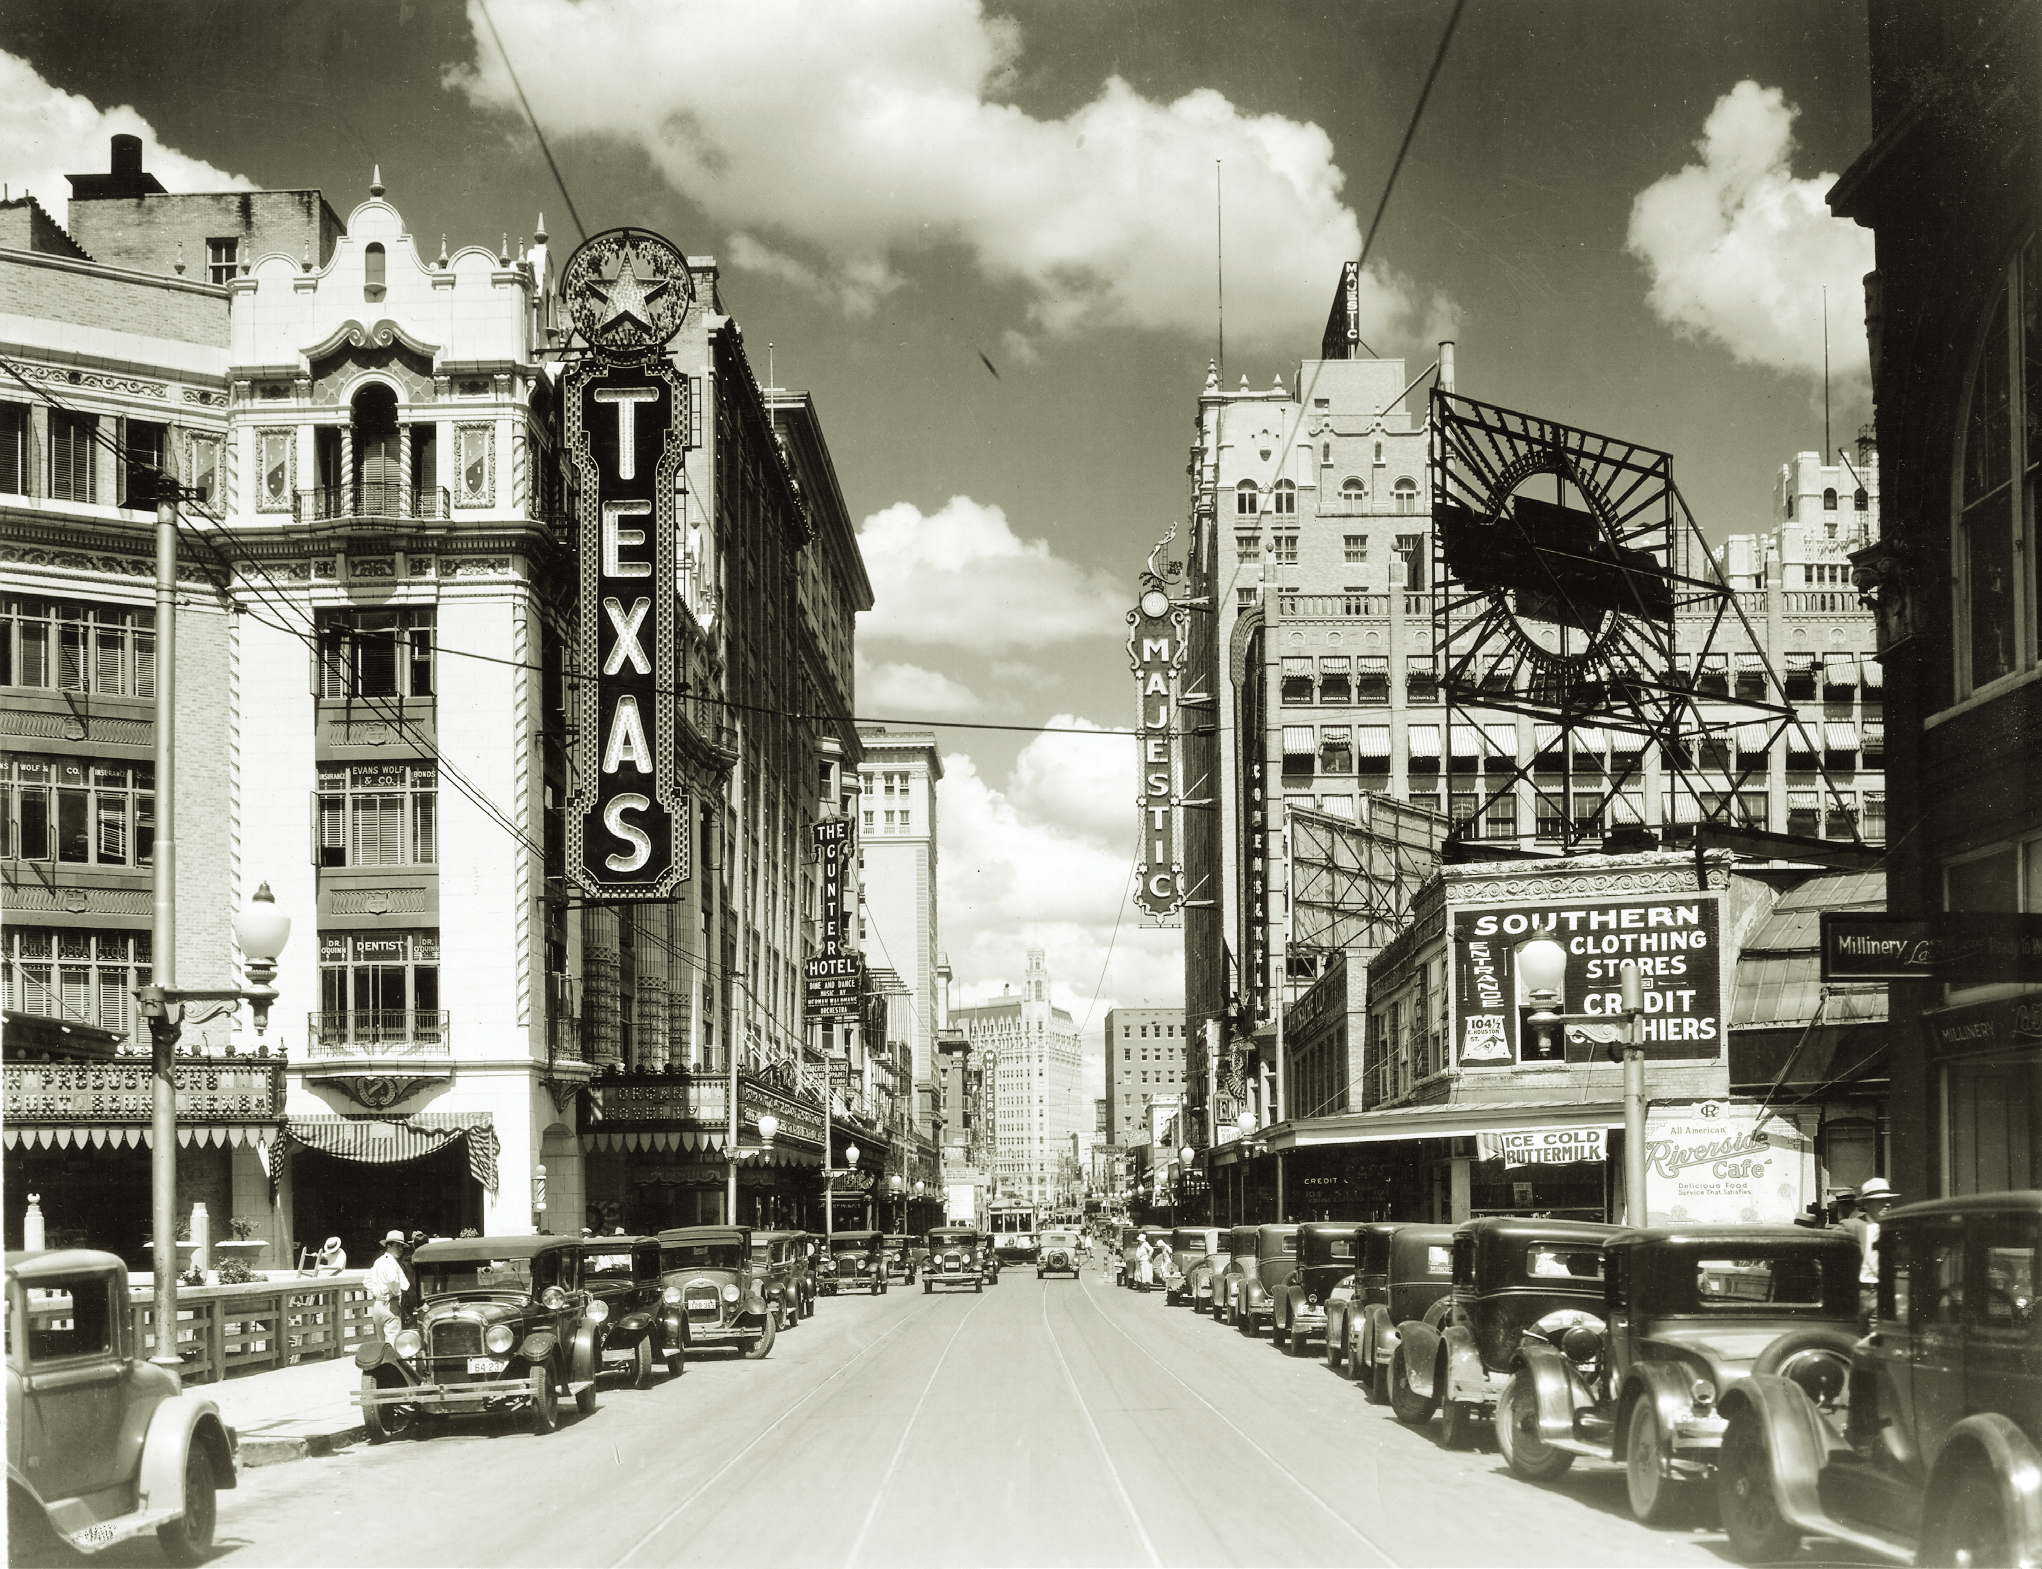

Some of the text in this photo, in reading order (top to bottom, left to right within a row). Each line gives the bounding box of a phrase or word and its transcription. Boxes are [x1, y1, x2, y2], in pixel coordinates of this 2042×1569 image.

[1346, 262, 1358, 339] MAJESTIC
[593, 385, 660, 873] TEXAS
[42, 765, 49, 773] &
[66, 767, 80, 775] CO.
[95, 769, 126, 778] INSURANCE
[352, 766, 405, 775] EVANS WOLF
[1142, 637, 1171, 898] MAJESTIC
[364, 776, 394, 785] & CO.
[817, 823, 845, 840] THE
[827, 844, 836, 956] GUNTER
[1474, 905, 1699, 936] SOUTHERN
[357, 941, 404, 951] DENTIST
[413, 945, 440, 953] O'QUINN
[1570, 930, 1707, 955] CLOTHING
[1838, 935, 1908, 958] Millinery
[809, 959, 855, 976] HOTEL
[1469, 941, 1504, 1008] ENTRANCE
[824, 980, 835, 989] AND
[837, 979, 856, 988] DANCE
[820, 1006, 847, 1014] ORCHESTRA
[1583, 989, 1697, 1015] CRDIT
[1570, 1017, 1717, 1043] HIERS
[1941, 1021, 1995, 1043] MILLINERY
[42, 1071, 219, 1090] PRODUCTONS
[618, 1086, 684, 1100] ORGAN
[985, 1052, 995, 1144] WHEELER GILL
[91, 1094, 153, 1112] SOUN
[190, 1095, 249, 1113] NEWS
[1505, 1131, 1600, 1148] ICE COLD
[1670, 1126, 1727, 1135] All American
[1506, 1145, 1602, 1165] BUTTERMILK
[1645, 1131, 1770, 1179] Riverside
[1304, 1177, 1338, 1185] CREDIT
[1723, 1188, 1752, 1196] Satisfies
